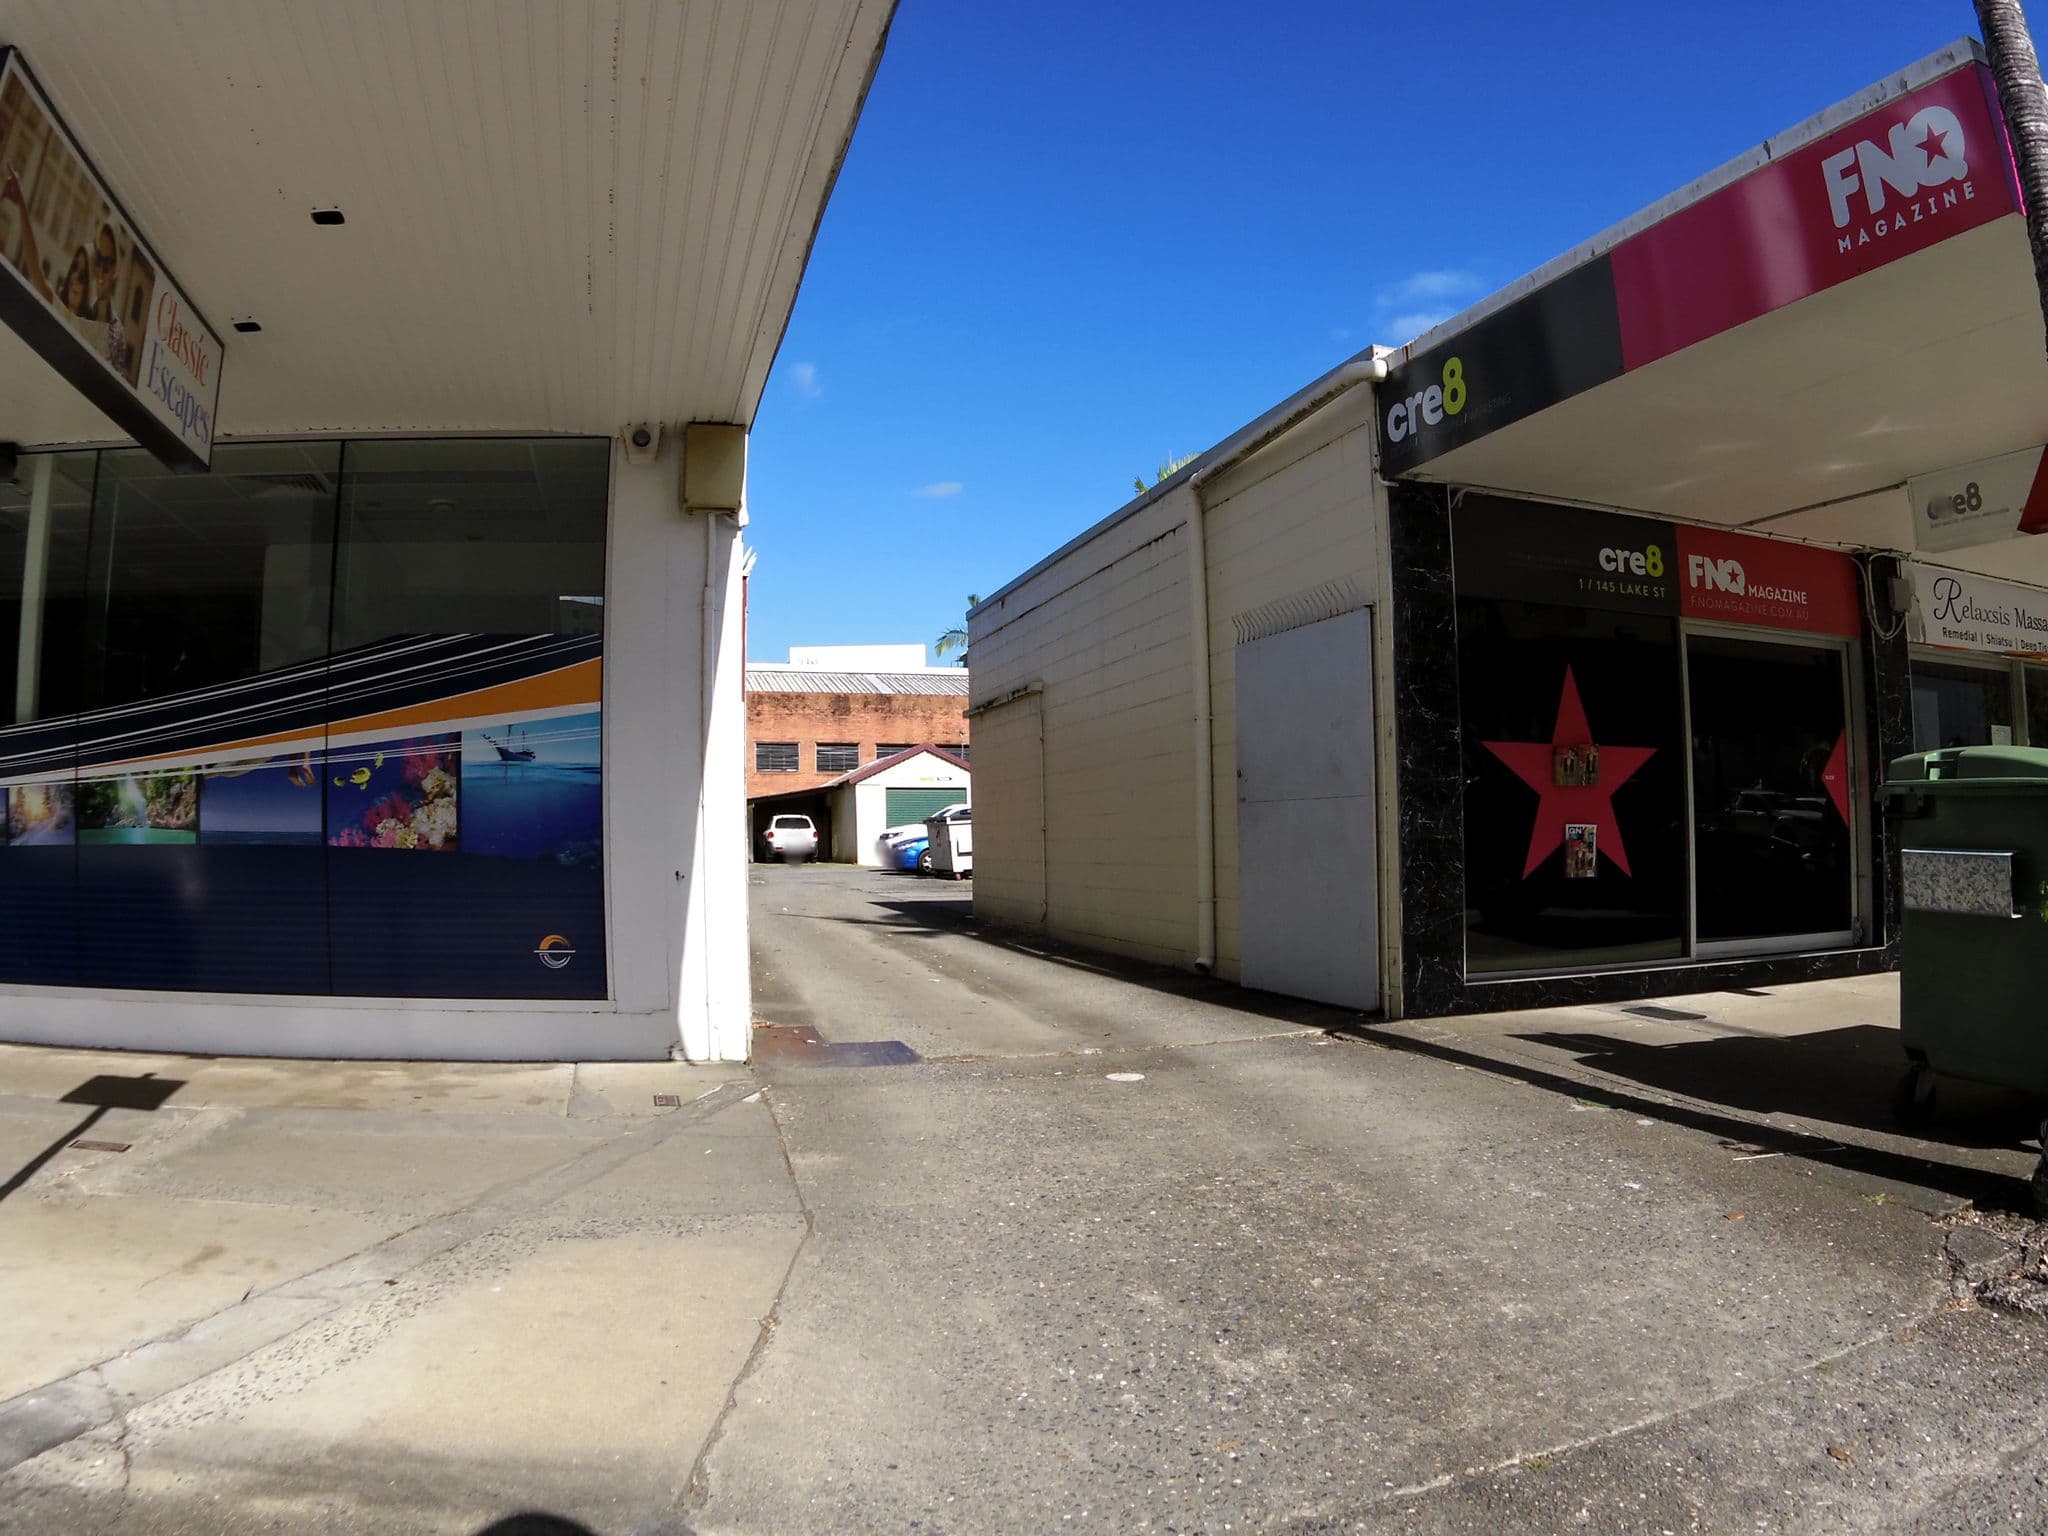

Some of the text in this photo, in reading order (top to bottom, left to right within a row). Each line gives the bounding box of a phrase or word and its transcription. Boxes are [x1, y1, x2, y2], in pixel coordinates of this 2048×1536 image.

[1821, 105, 1968, 228] FNQ
[1837, 181, 1975, 254] MAGAZINE
[157, 291, 208, 386] Classic
[147, 341, 210, 444] Escapes
[1386, 355, 1467, 443] cre8
[1927, 482, 1983, 520] e8
[1598, 544, 1664, 577] cre8
[1688, 554, 1808, 604] FNQ MAGAZINE
[1619, 583, 1649, 596] LAKE
[1653, 586, 1664, 598] ST
[1933, 577, 2010, 625] Relaxsis
[1942, 627, 1978, 642] Remedial
[1986, 633, 2013, 647] Shiatsu
[2020, 639, 2037, 651] Deep
